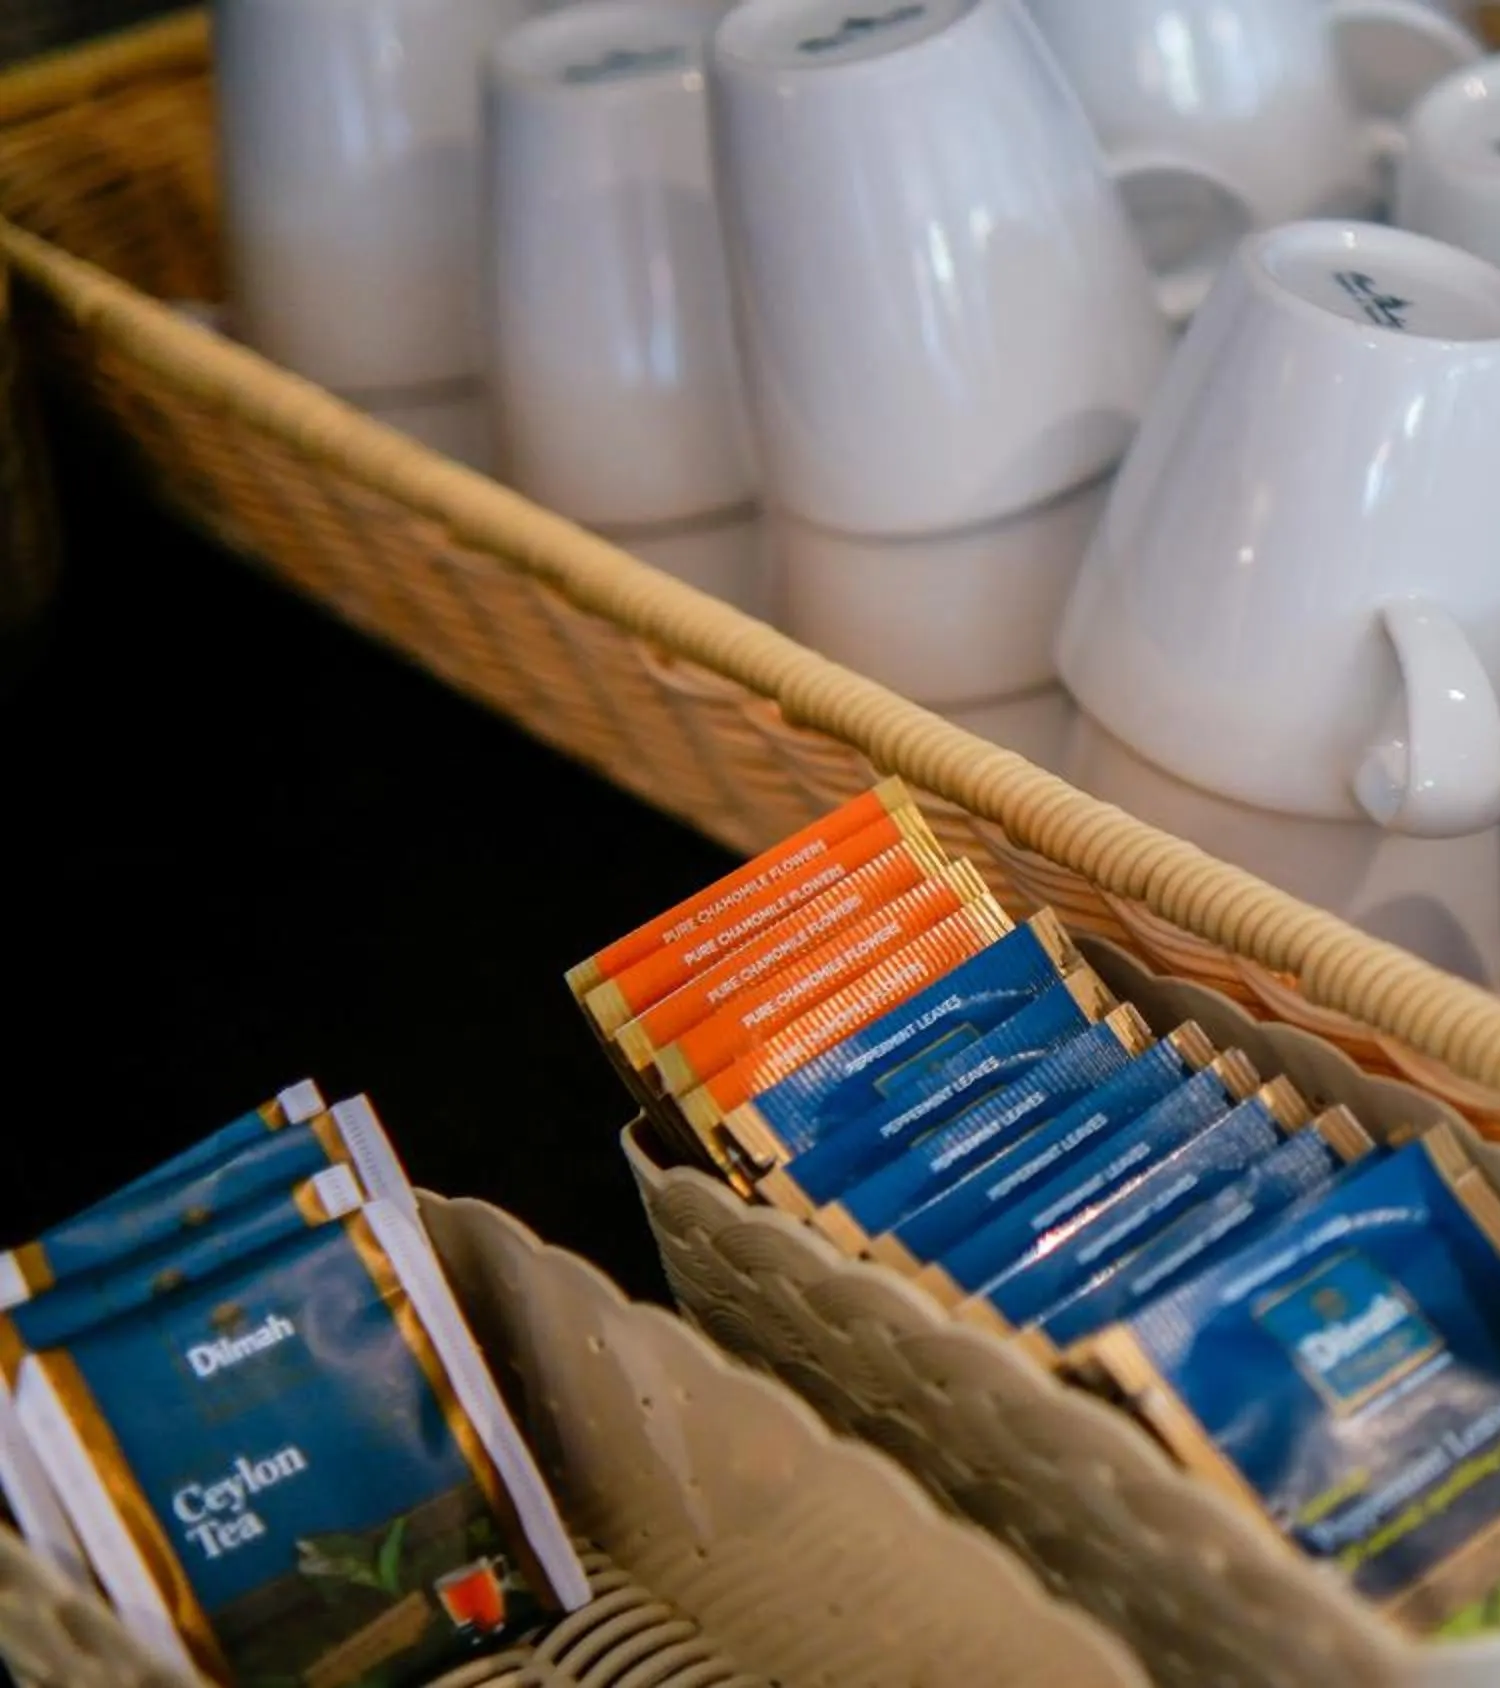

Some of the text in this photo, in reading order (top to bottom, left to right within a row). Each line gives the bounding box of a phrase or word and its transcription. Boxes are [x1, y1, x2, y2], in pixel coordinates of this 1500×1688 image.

[663, 840, 826, 944] PURE CHAMOMILE FLOWERS
[684, 864, 844, 966] PURE CHAMOMILE FLOWERS
[707, 896, 861, 1002] PURE CHAMOMILE FLOWERS
[743, 1000, 777, 1027] PURE
[845, 922, 901, 962] FLOWERS
[844, 1024, 916, 1075] PEPPERMINT
[916, 995, 961, 1029] LEAVES
[880, 1057, 999, 1137] PEPPERMINT LEAVES
[1000, 1092, 1045, 1126] LEAVES
[1060, 1113, 1108, 1150] LEAVES
[186, 1314, 295, 1377] Dilmah
[173, 1444, 308, 1525] Ceylon
[186, 1504, 265, 1560] Tea
